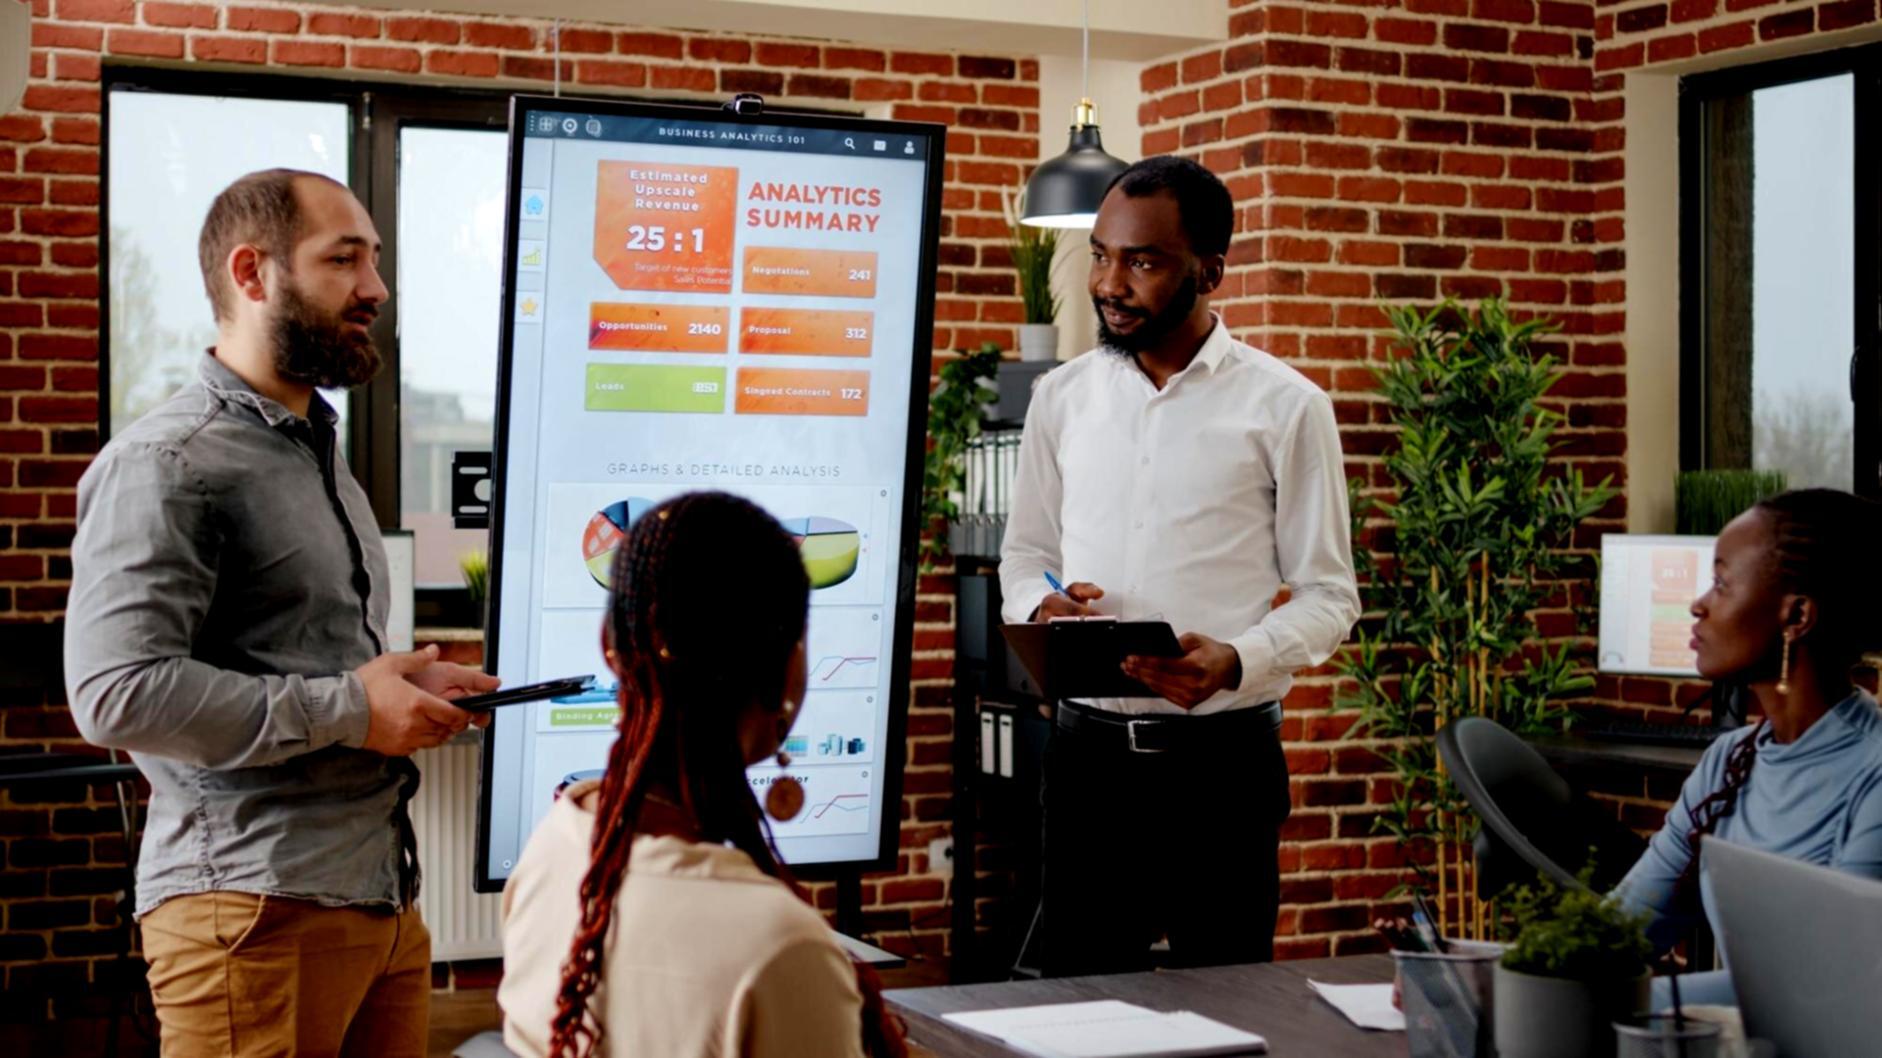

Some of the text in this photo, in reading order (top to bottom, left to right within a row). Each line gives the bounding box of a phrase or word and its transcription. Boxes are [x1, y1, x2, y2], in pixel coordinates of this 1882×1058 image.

[658, 127, 806, 145] BUSINESS ANALYTICS 101
[630, 169, 708, 184] Estimated
[635, 184, 696, 197] Upscale
[747, 181, 882, 208] ANALYTICS
[635, 199, 700, 211] Revenue
[746, 208, 881, 233] SUMMARY
[626, 224, 666, 251] 25
[691, 228, 705, 253] 1
[660, 264, 671, 272] of
[848, 268, 872, 281] 241
[598, 320, 722, 335] Opportunities 2140
[748, 325, 868, 339] Proposal 312
[595, 382, 625, 391] Leads
[784, 387, 832, 397] Contracts
[841, 388, 863, 400] 172
[606, 462, 841, 478] GRAPHS & DETAILED ANALYSIS
